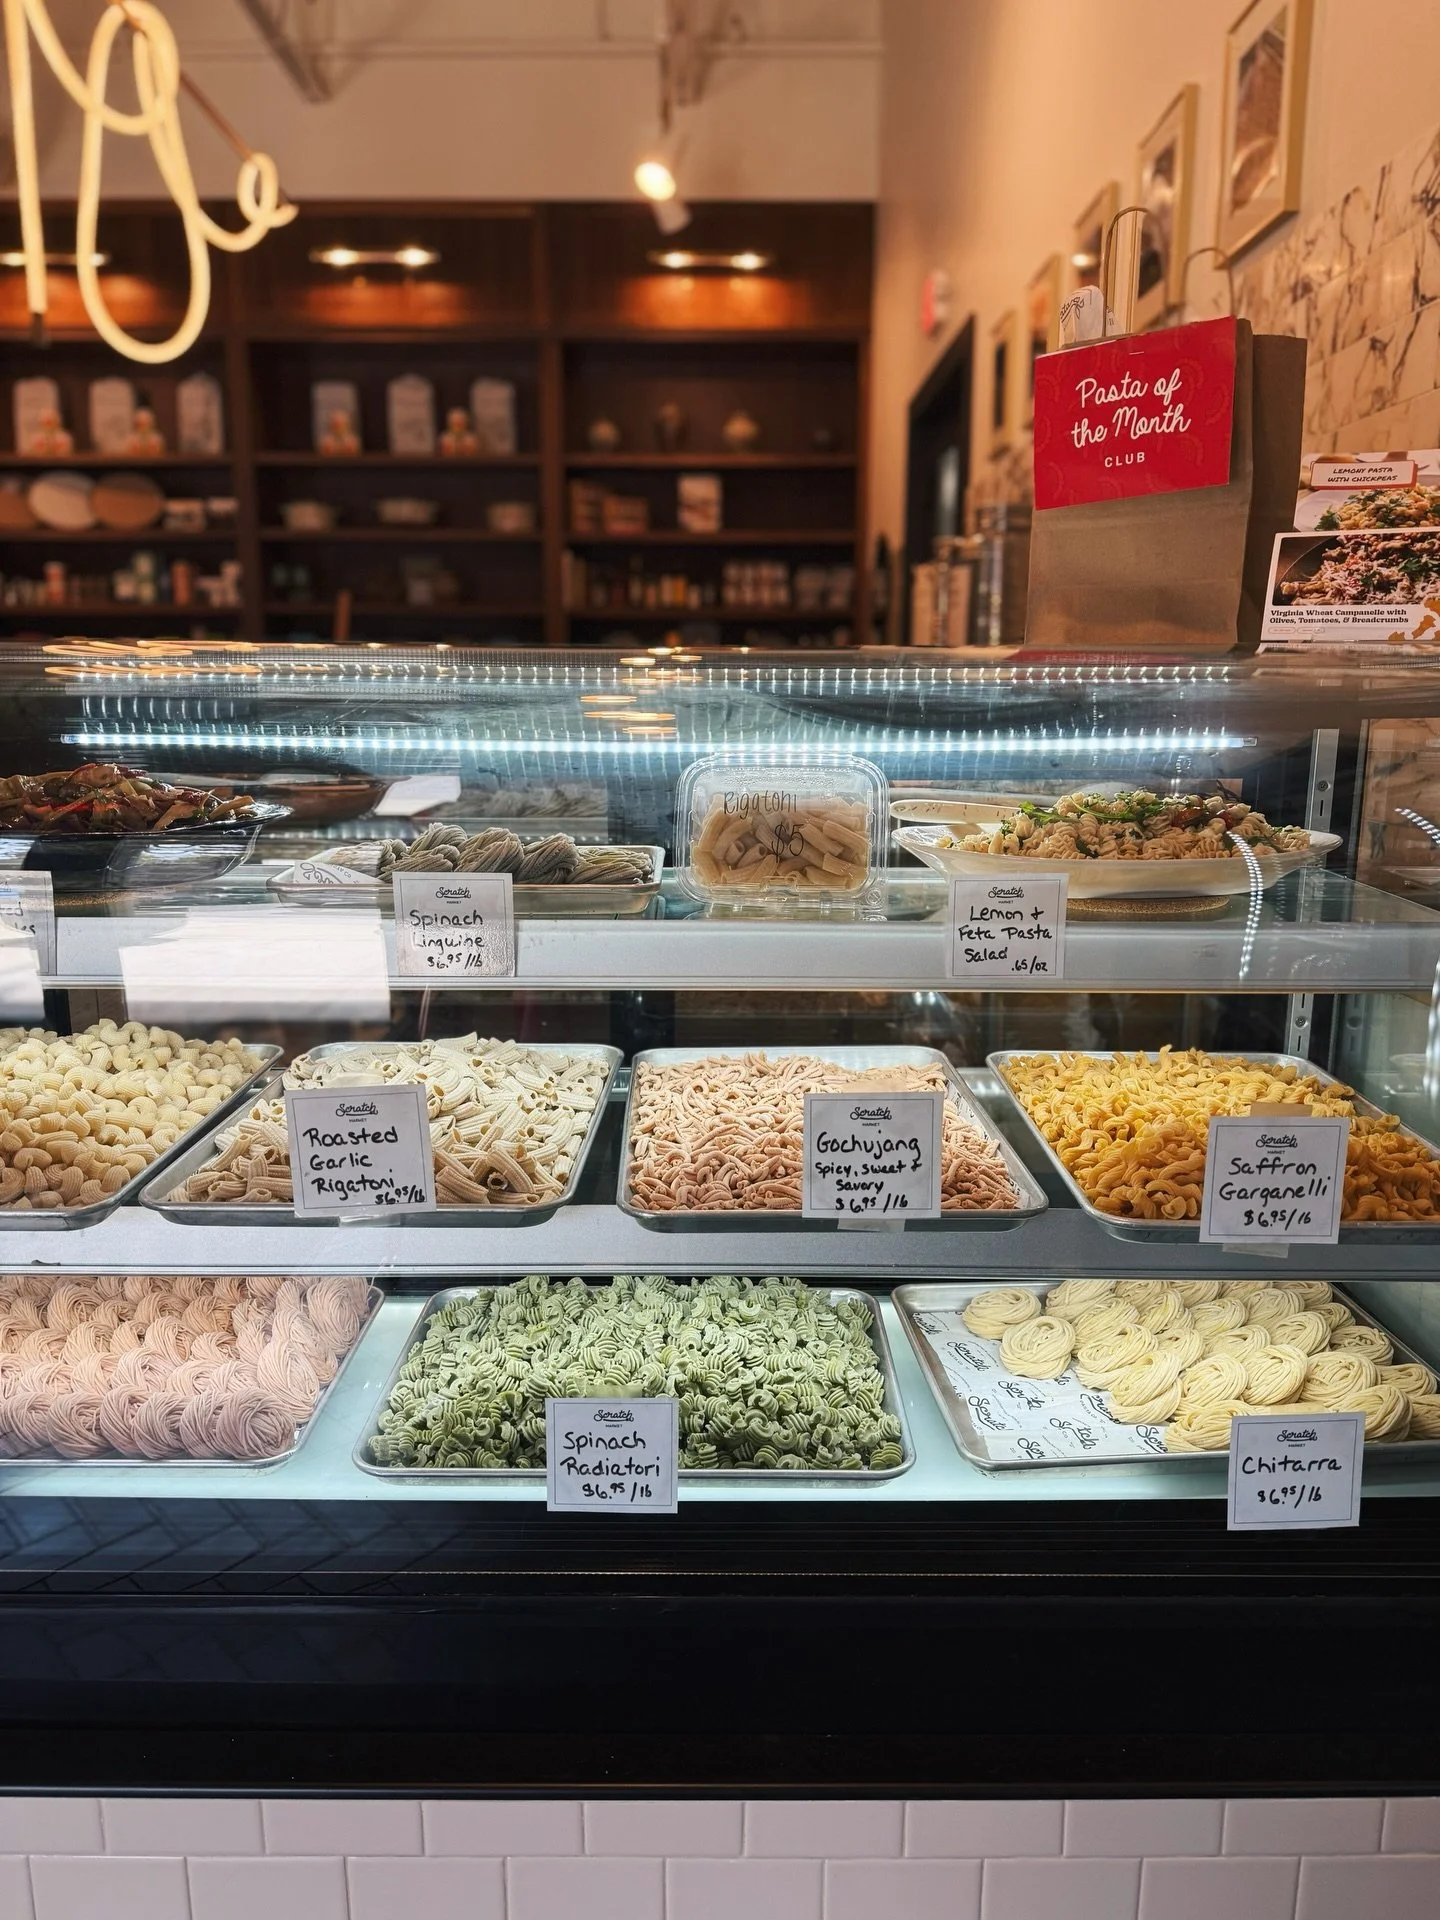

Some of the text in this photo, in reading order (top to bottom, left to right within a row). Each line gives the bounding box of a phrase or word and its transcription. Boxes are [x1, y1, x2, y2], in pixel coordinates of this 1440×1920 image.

[1075, 367, 1183, 408] Pasta of
[1071, 402, 1192, 448] the Month
[1104, 451, 1145, 468] CLUB
[1333, 466, 1393, 475] LEMONY PASTA
[1269, 617, 1297, 625] Olives,
[1298, 617, 1341, 625] Tomatoes,
[1271, 609, 1304, 617] Virginia
[1335, 609, 1385, 617] Campanelle
[771, 822, 805, 863] $5
[435, 886, 471, 899] Scratch
[988, 886, 1025, 899] Scratch
[409, 909, 484, 930] Spinach
[969, 905, 1024, 921] Lemon
[958, 923, 1053, 941] Feta Pasta
[412, 931, 485, 956] Linguine
[964, 946, 1008, 963] Salad
[335, 1102, 379, 1117] Scratch
[849, 1106, 893, 1121] Scratch
[302, 1126, 399, 1148] Roasted
[816, 1129, 922, 1161] Gochujang
[1255, 1133, 1298, 1148] Scratch
[309, 1152, 373, 1171] Garlic
[1228, 1156, 1317, 1175] Saffron
[311, 1168, 395, 1201] Rigatoni
[1218, 1176, 1332, 1207] Garganelli
[947, 1341, 991, 1372] Scratch
[593, 1409, 635, 1422] Scratch
[563, 1431, 647, 1455] Spinach
[1276, 1429, 1318, 1442] Scratch
[560, 1455, 660, 1477] Radiatori
[1242, 1455, 1343, 1474] Chitarra
